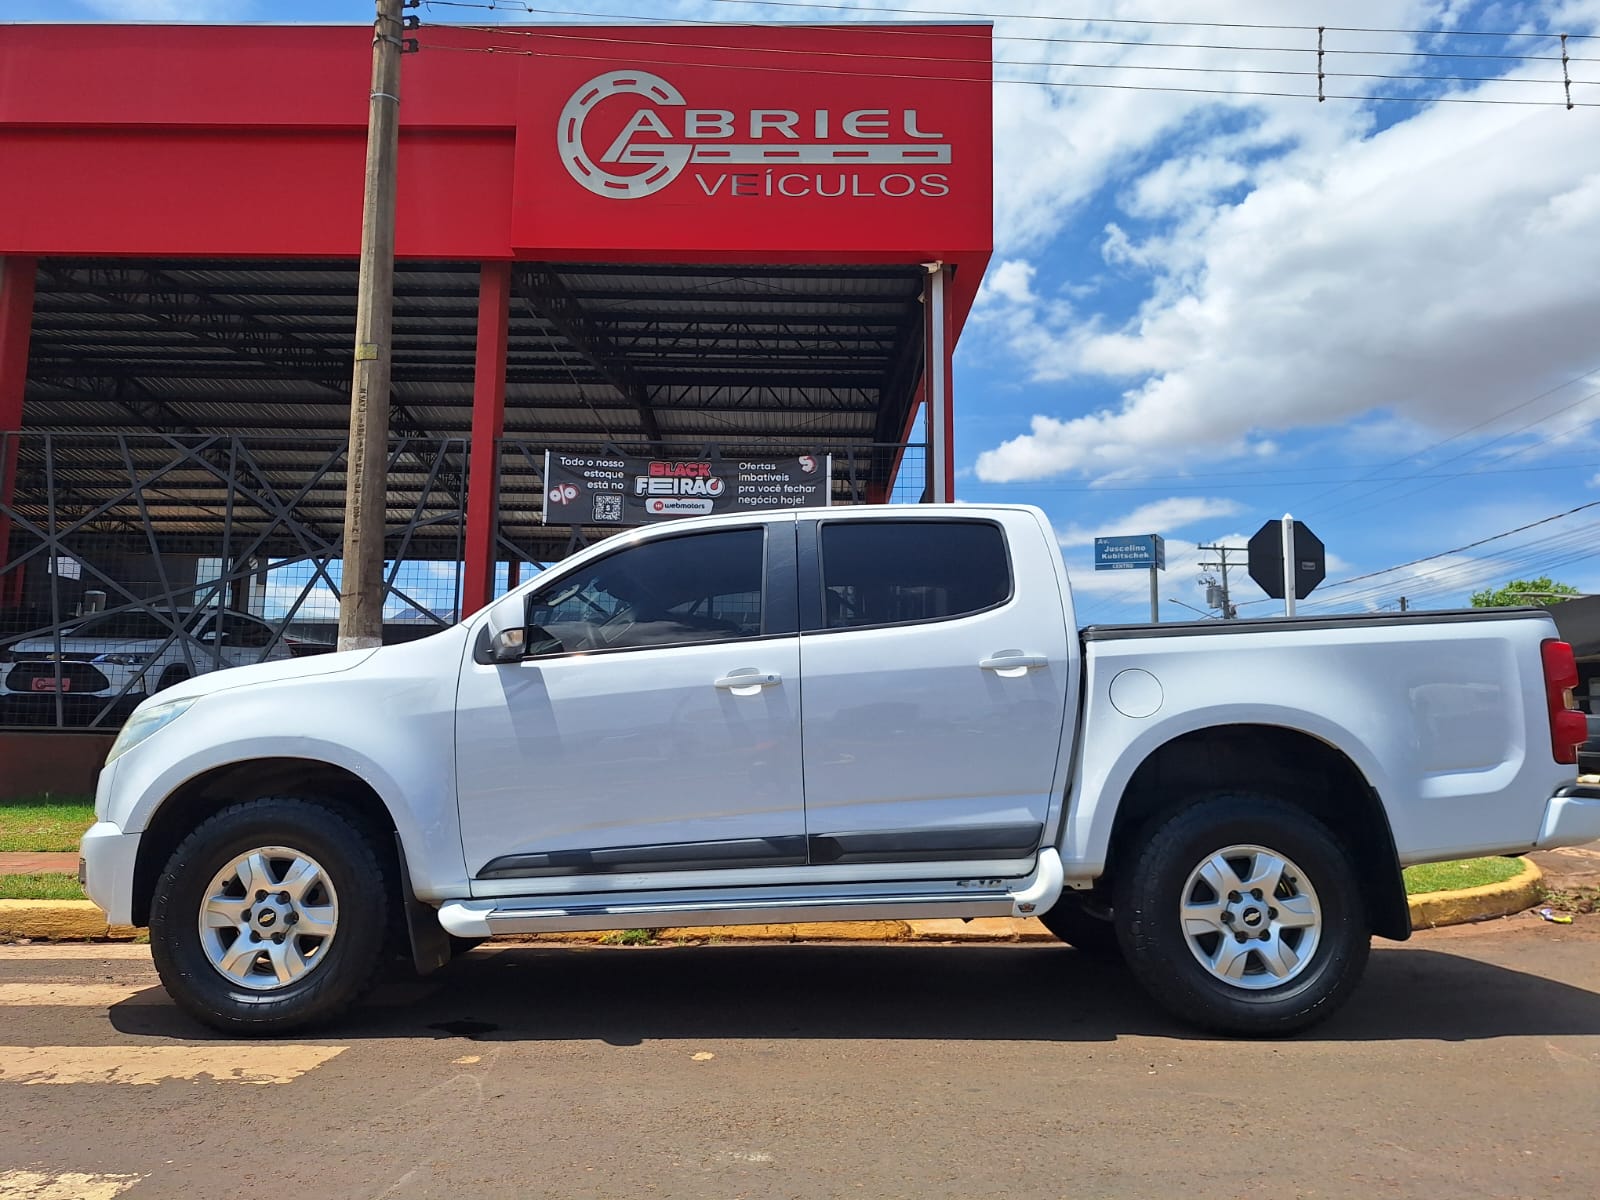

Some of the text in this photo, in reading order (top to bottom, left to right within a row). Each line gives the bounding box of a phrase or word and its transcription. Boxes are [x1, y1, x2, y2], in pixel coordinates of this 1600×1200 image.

[695, 168, 950, 197] VEÍCULOS
[560, 457, 584, 466] Todo
[587, 459, 594, 467] o
[738, 462, 776, 470] Ofertas
[584, 470, 624, 479] estoque
[650, 463, 710, 476] BLACK
[587, 481, 608, 489] está
[636, 476, 723, 496] FEIRÃO
[738, 484, 816, 494] pra você fechar
[664, 502, 705, 510] webmotors
[738, 496, 805, 506] negócio hoje!
